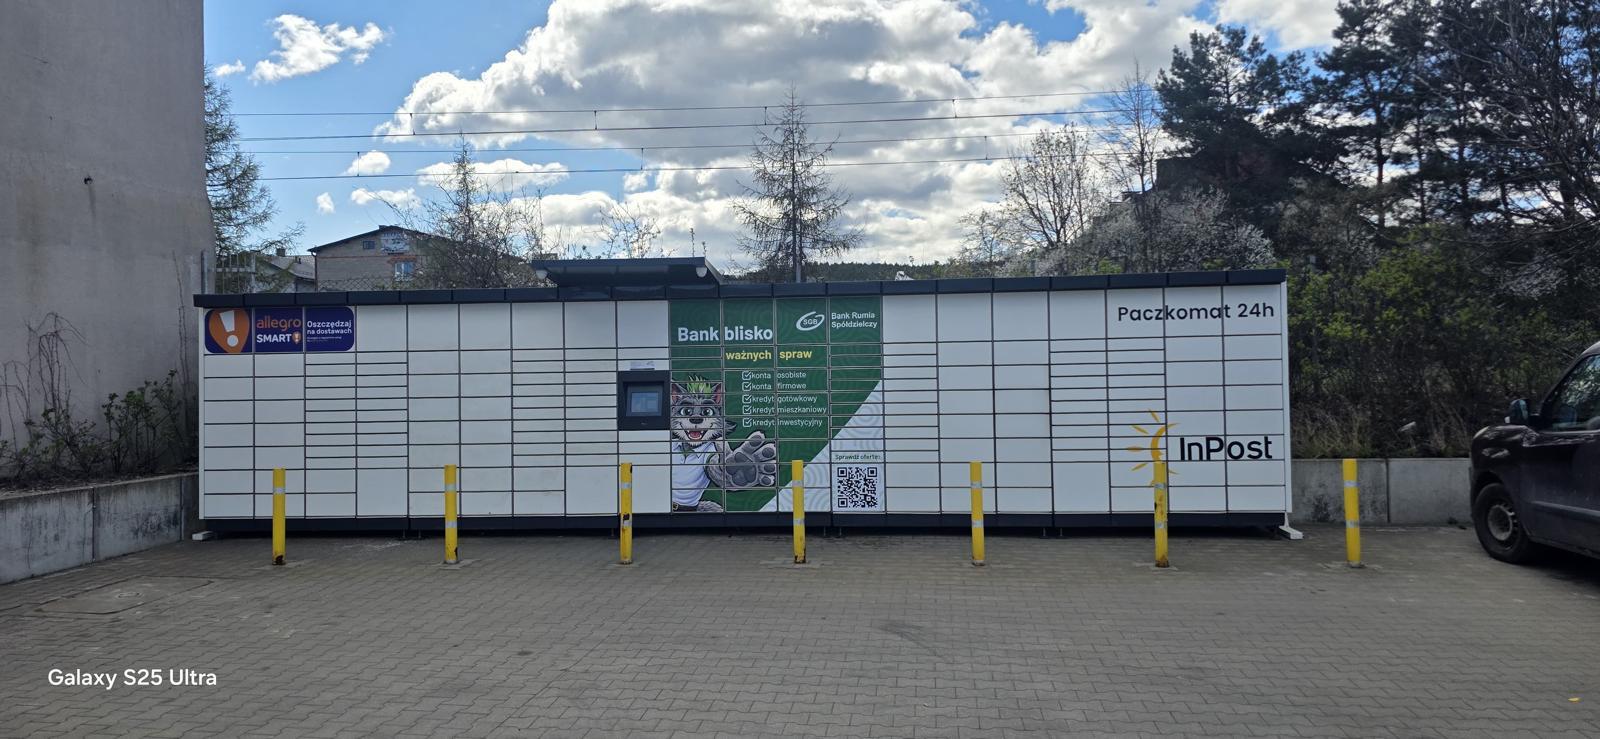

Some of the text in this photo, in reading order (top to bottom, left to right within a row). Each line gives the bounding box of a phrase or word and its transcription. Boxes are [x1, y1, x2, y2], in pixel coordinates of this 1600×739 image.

[831, 311, 875, 320] Bank Rumia
[1118, 302, 1274, 321] Paczkomat 24h
[256, 315, 302, 332] allegro
[307, 319, 352, 329] Oszczędzaj
[831, 319, 878, 329] Spółdzielczy
[316, 327, 352, 335] dostawach
[677, 325, 773, 342] Bank blisko
[725, 350, 813, 362] ważnych spraw
[751, 370, 807, 379] konta osobiste
[752, 395, 818, 404] kredyt gotówkowy
[752, 405, 827, 415] kredyt mieszkaniowy
[752, 418, 823, 428] kredyt inwestycyjny
[1180, 436, 1273, 461] InPost
